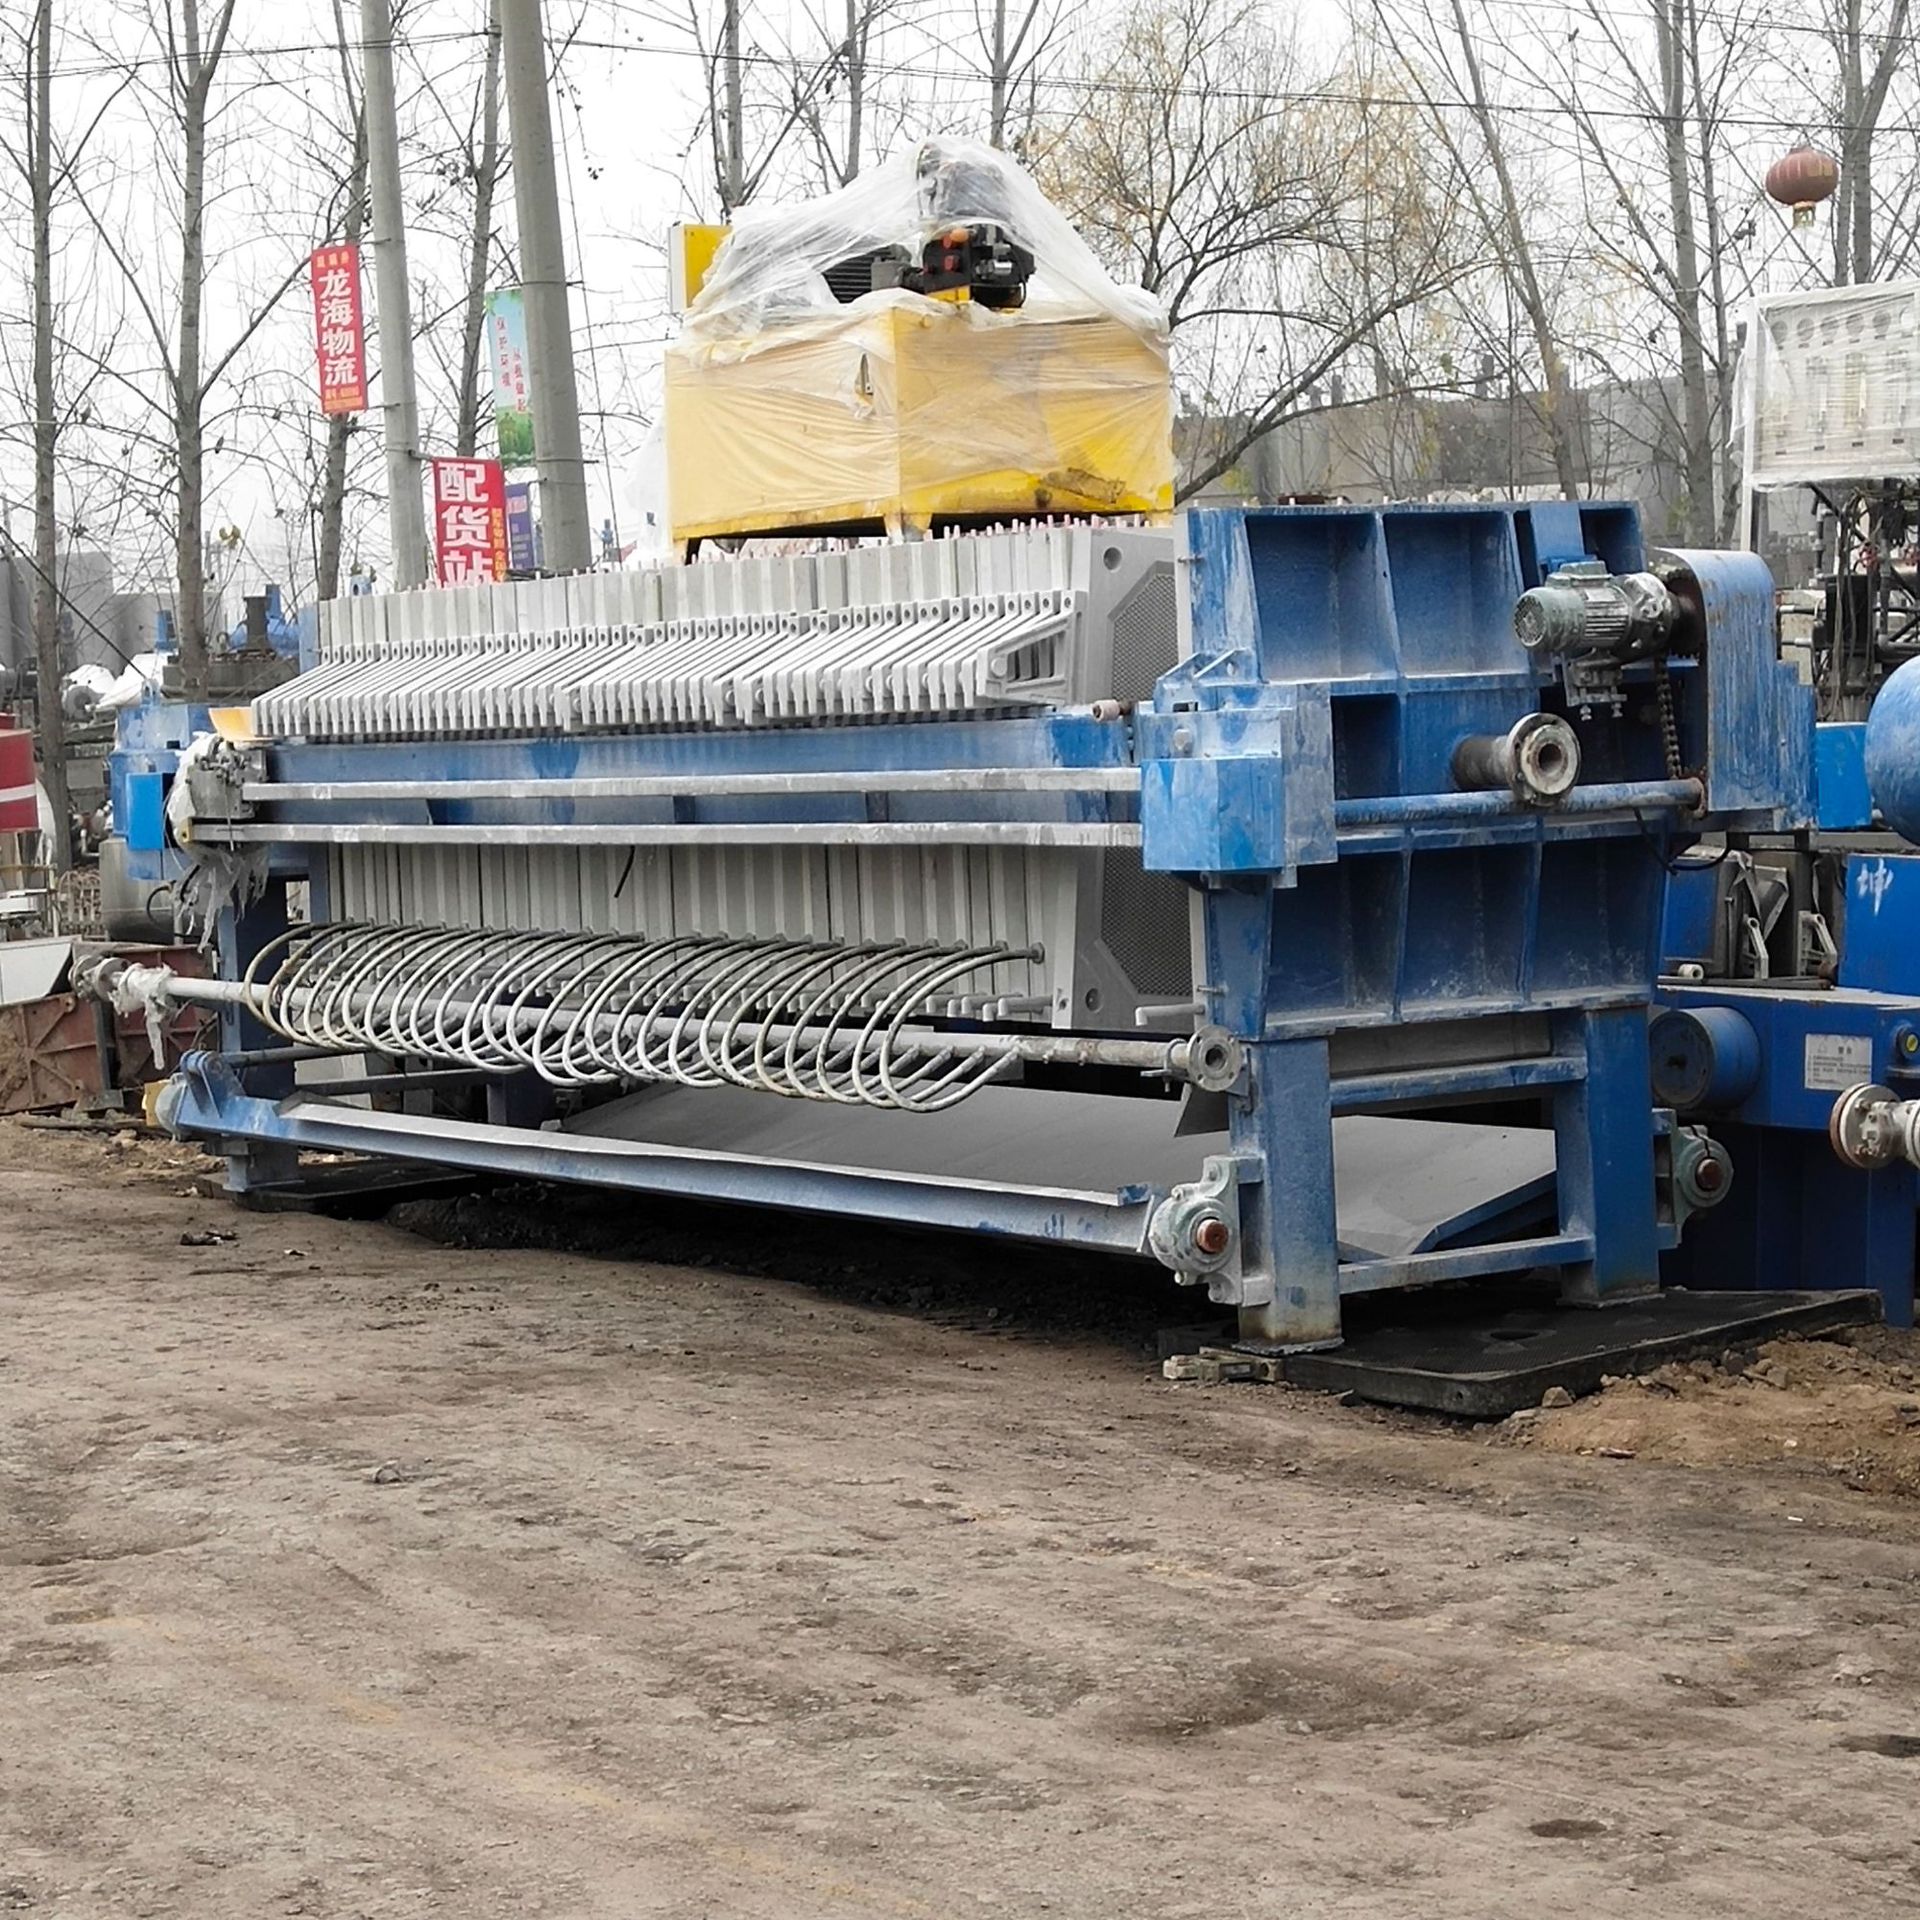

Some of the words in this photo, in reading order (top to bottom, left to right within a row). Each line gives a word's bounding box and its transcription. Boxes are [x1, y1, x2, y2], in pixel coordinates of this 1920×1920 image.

[318, 268, 358, 385] 龙海物流
[438, 461, 493, 585] 配货站
